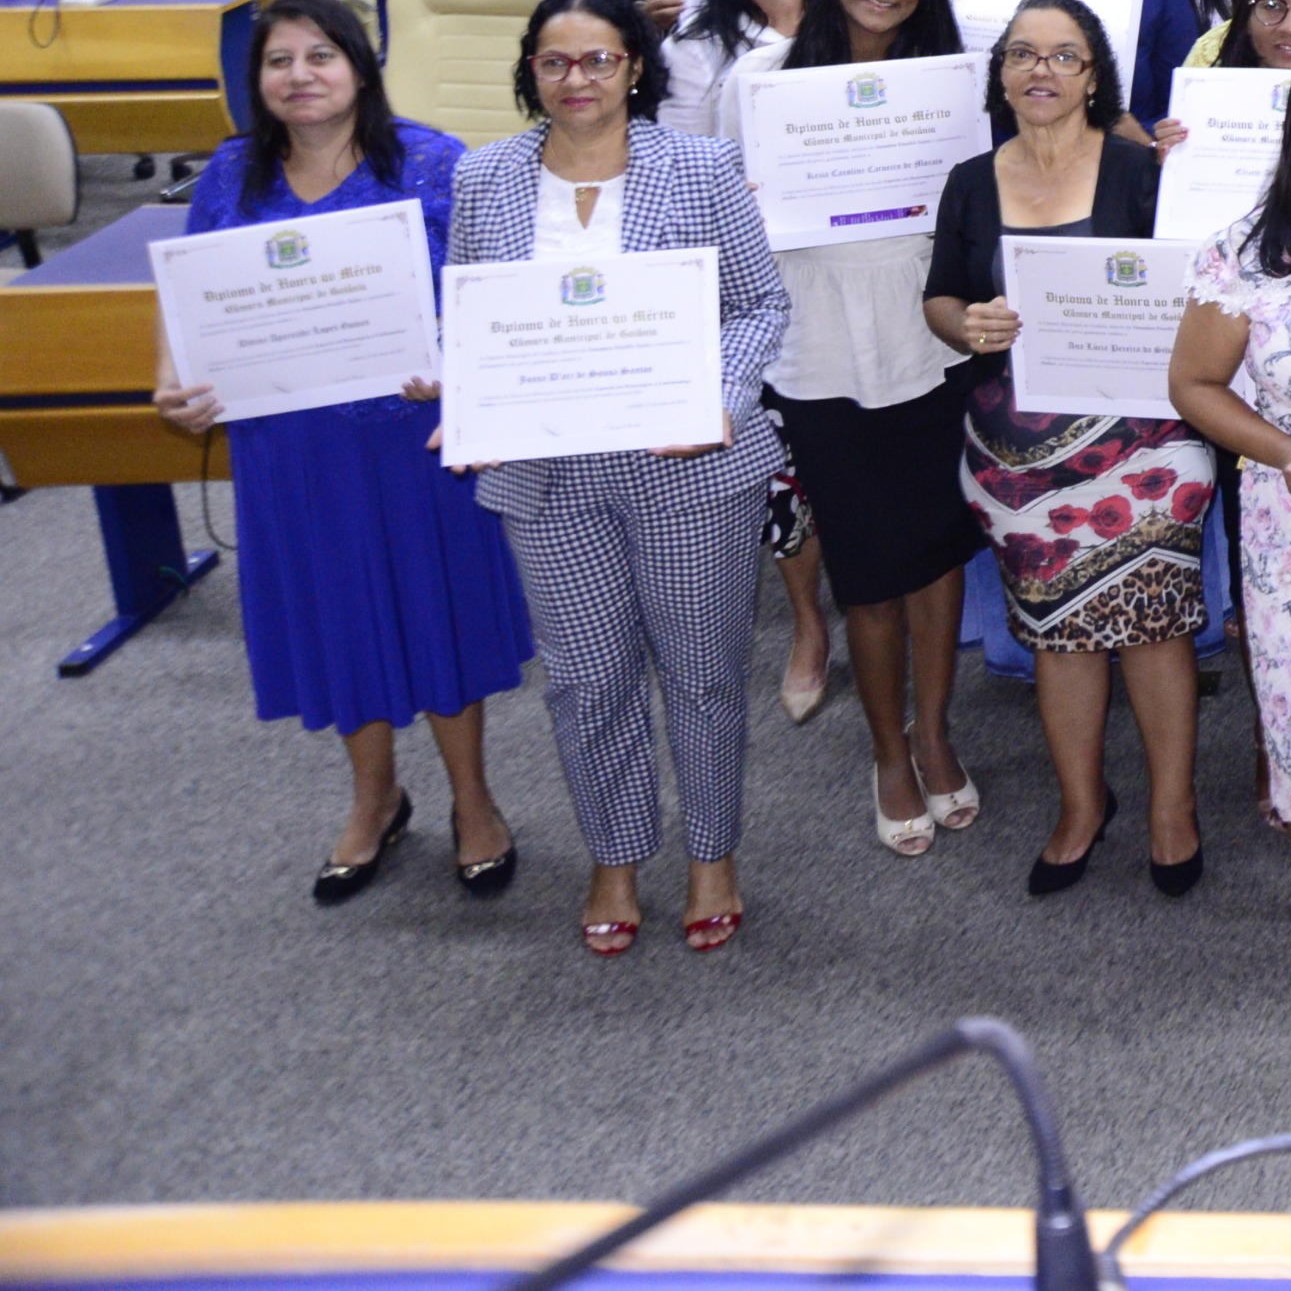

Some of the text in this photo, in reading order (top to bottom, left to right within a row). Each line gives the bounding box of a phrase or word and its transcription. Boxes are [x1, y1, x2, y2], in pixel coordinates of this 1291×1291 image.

[785, 109, 952, 135] Diploma de Honra ao Mérito
[804, 127, 937, 147] Câmara Municipal de Goiânia
[1046, 292, 1168, 308] Diploma de Honra ao
[1063, 309, 1183, 322] Câmara Municipal de Goiâ
